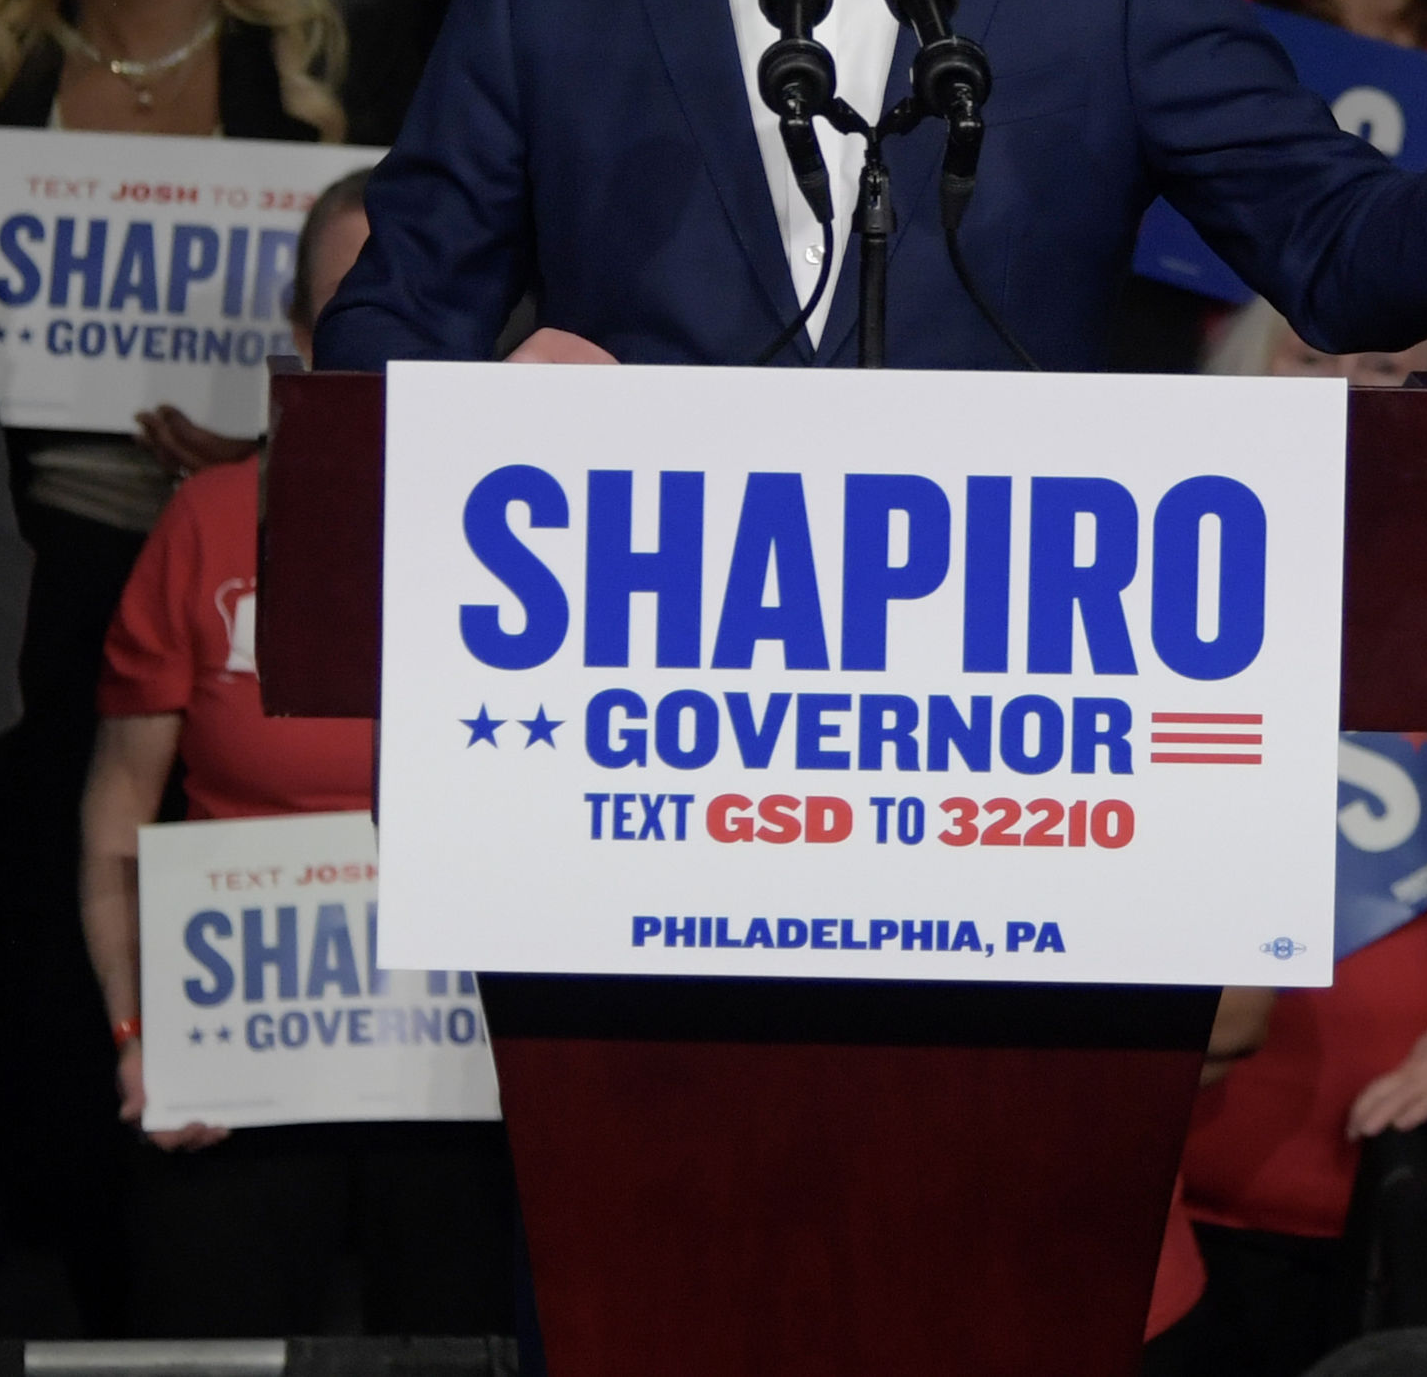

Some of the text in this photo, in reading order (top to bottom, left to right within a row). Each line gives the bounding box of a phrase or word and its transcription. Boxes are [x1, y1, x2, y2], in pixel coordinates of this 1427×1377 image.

[27, 177, 314, 212] TEXT JOSH TO 322
[47, 320, 295, 367] GOVERNO
[459, 464, 1267, 681] SHAPIRO
[585, 688, 1134, 775] GOVERNOR
[586, 793, 1135, 848] TEXT GSD TO 32210
[207, 868, 281, 891] TEXT
[632, 916, 1065, 958] PHILADELPHIA, PA
[246, 1008, 485, 1051] GOVERNO
